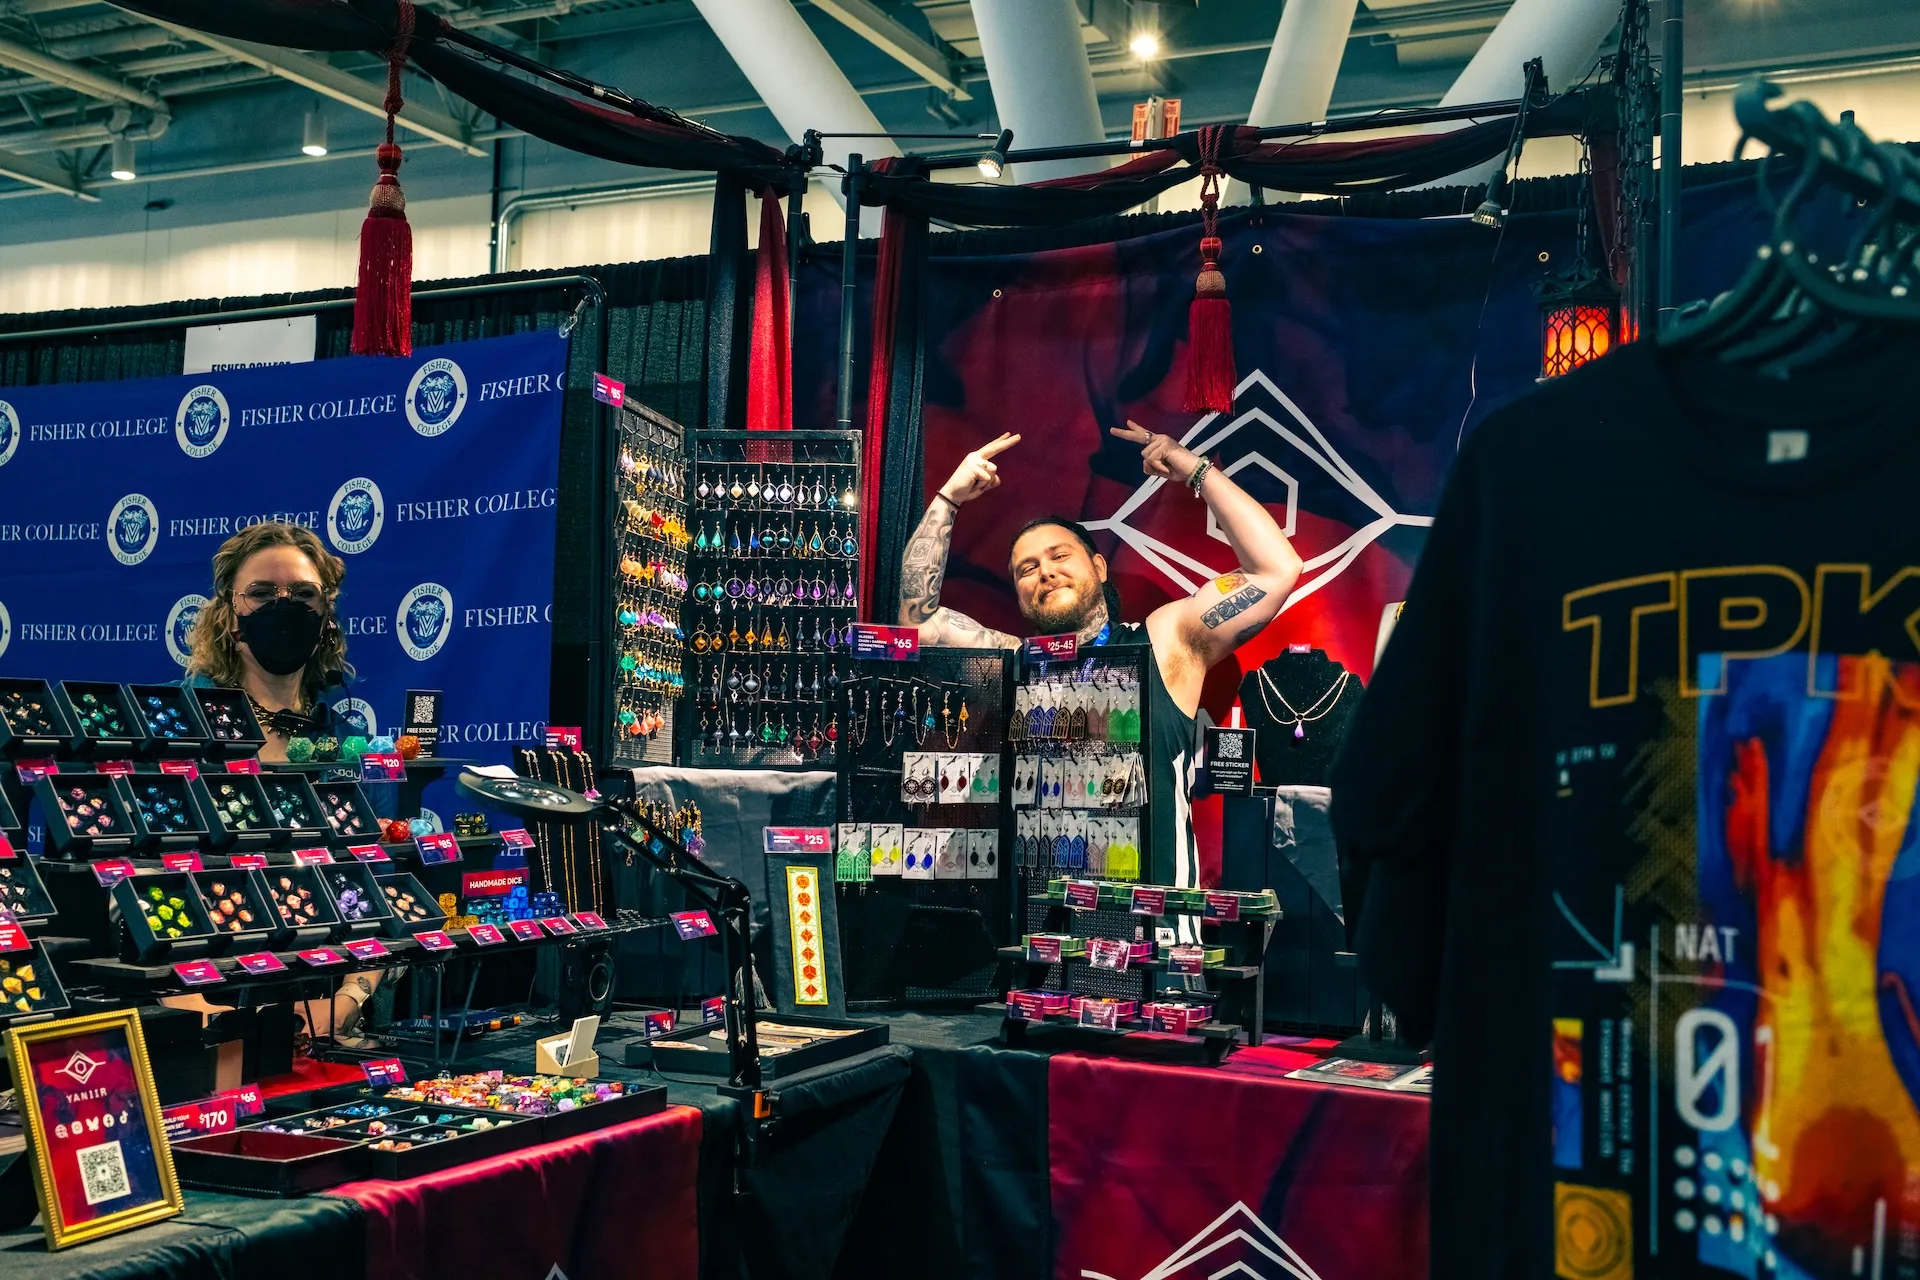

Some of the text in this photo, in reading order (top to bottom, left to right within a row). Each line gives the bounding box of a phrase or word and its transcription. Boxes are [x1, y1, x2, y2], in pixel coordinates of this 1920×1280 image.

[422, 361, 453, 375] FISHER
[190, 386, 217, 400] FISHER
[479, 373, 552, 402] FISHER
[241, 394, 397, 427] FISHER COLLEGE
[30, 417, 169, 442] FISHER COLLEGE
[416, 418, 454, 436] COLLEGE
[185, 441, 219, 457] COLLEGE
[344, 480, 372, 493] FISHER
[120, 496, 147, 508] FISHER
[396, 487, 559, 522] FISHER COLLEG
[25, 523, 100, 542] COLLEGE
[170, 516, 230, 537] FISHER
[336, 536, 374, 553] COLLEGE
[116, 549, 149, 565] COLLEGE
[412, 585, 443, 599] FISHER
[464, 605, 539, 628] FISHER
[20, 623, 158, 641] FISHER COLLEGE
[1562, 563, 1920, 708] TPK
[894, 637, 912, 649] $65
[1047, 640, 1074, 651] $25-45
[409, 643, 441, 661] COLLEGE
[388, 721, 550, 745] FIER COLLEG
[564, 734, 577, 746] $75
[383, 758, 400, 768] $120
[327, 769, 361, 781] ady
[437, 838, 453, 849] $85
[804, 834, 824, 845] $25
[470, 876, 522, 889] HANDMADE DICE
[1675, 923, 1740, 963] NAT
[662, 1020, 671, 1031] $4
[240, 1092, 256, 1103] $65
[199, 1110, 227, 1129] $170
